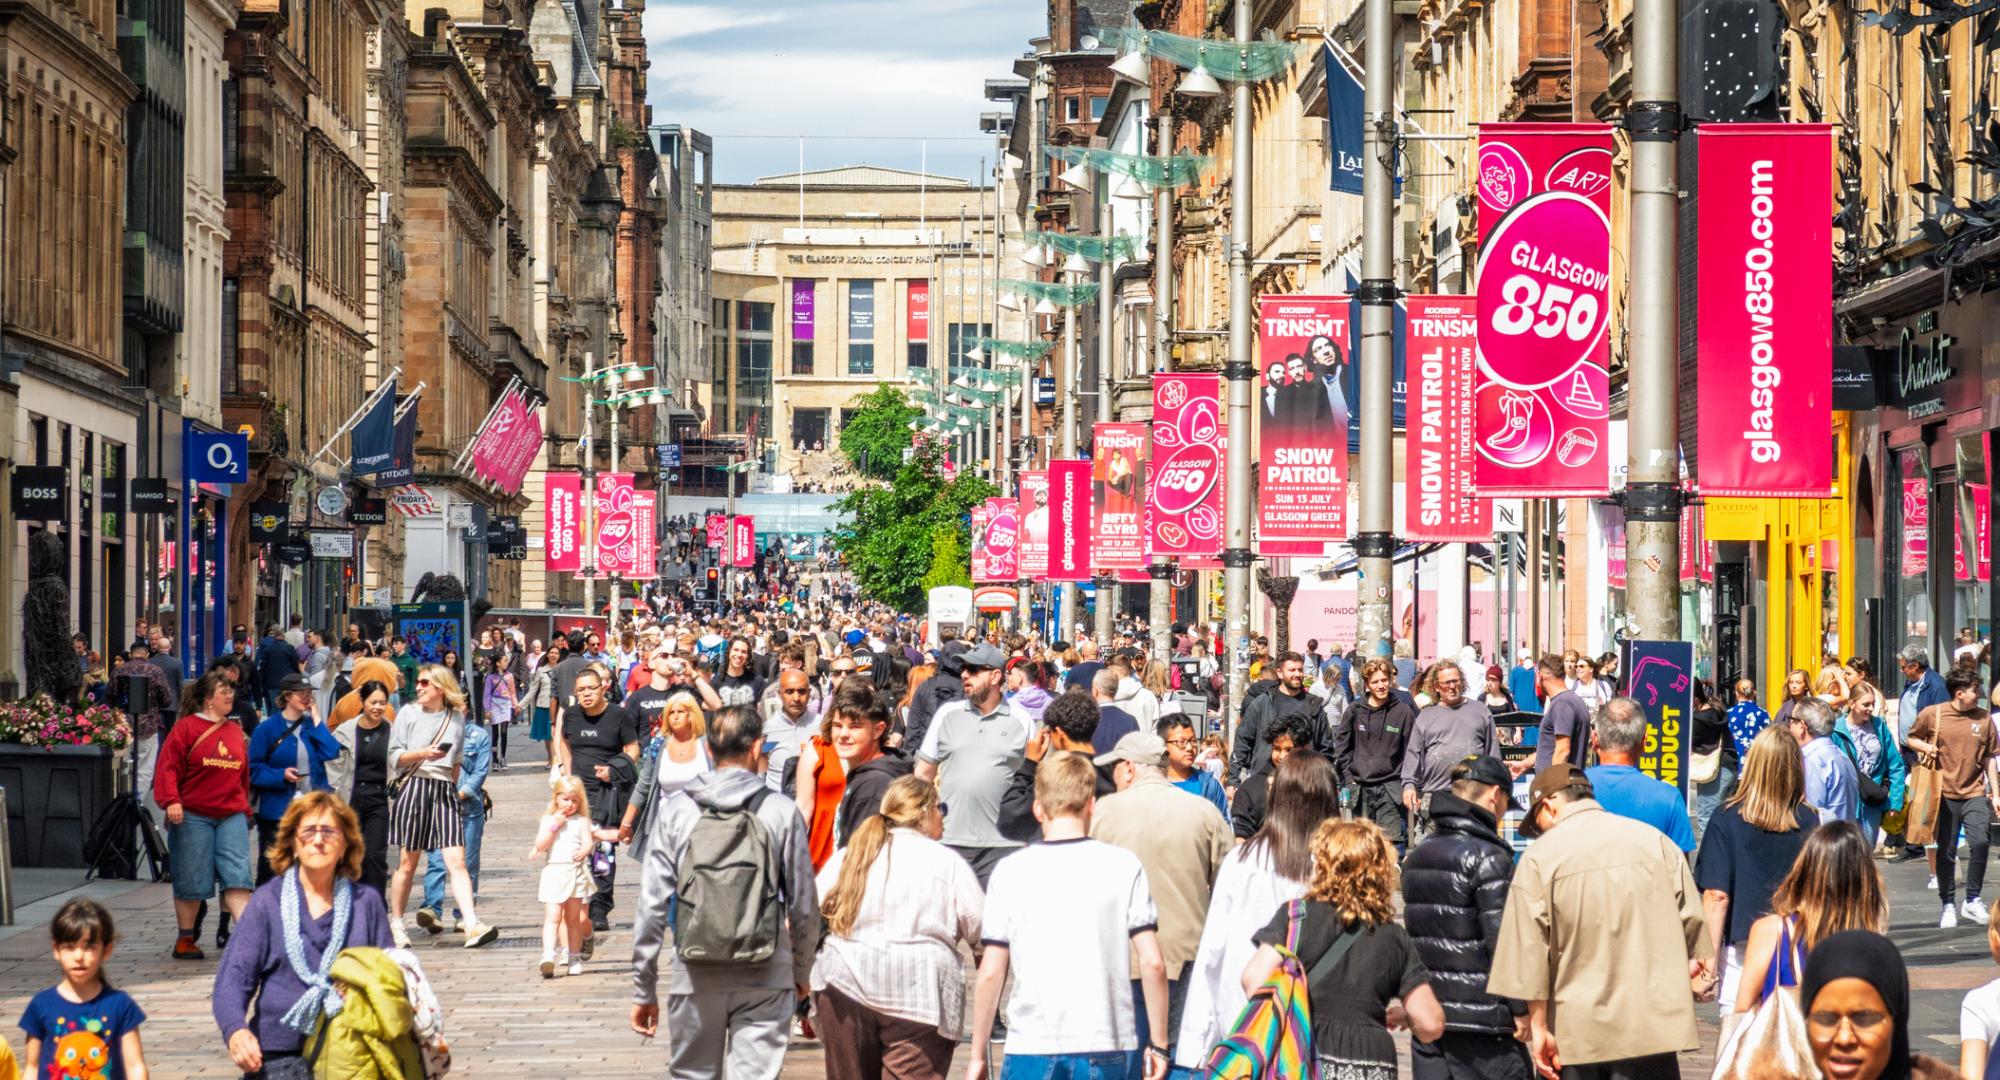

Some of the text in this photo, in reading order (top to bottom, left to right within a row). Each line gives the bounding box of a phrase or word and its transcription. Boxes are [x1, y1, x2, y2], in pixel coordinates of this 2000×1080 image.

[1554, 167, 1609, 191] ART
[788, 255, 803, 264] THE
[1511, 241, 1609, 291] GLASGOW
[1492, 274, 1598, 341] 850
[1744, 160, 1781, 463] glasgow850.com
[1264, 319, 1345, 337] TRNSMT
[1461, 347, 1471, 371] NOW
[1461, 373, 1471, 398] SALE
[1461, 400, 1471, 415] ON
[1096, 437, 1144, 448] TRNSMT
[1421, 346, 1443, 526] SNOW PATROL
[1461, 417, 1471, 458] TICKETS
[1169, 459, 1211, 468] GLASGOW
[1274, 448, 1334, 465] SNOW
[380, 468, 410, 479] TUDOR
[1160, 470, 1205, 493] 850
[1267, 466, 1341, 483] PATROL
[22, 488, 58, 499] BOSS
[397, 495, 427, 504] FRIDAYS
[1275, 494, 1332, 503] SUN 13 JULY
[550, 488, 564, 559] Celebrating
[563, 492, 576, 552] 850 years
[1061, 472, 1075, 570] glasgow850.com
[1103, 513, 1136, 524] BIFFY
[1264, 512, 1340, 521] GLASGOW GREEN
[602, 525, 626, 537] 850
[1101, 524, 1138, 534] CLYRO
[989, 531, 1015, 547] 850
